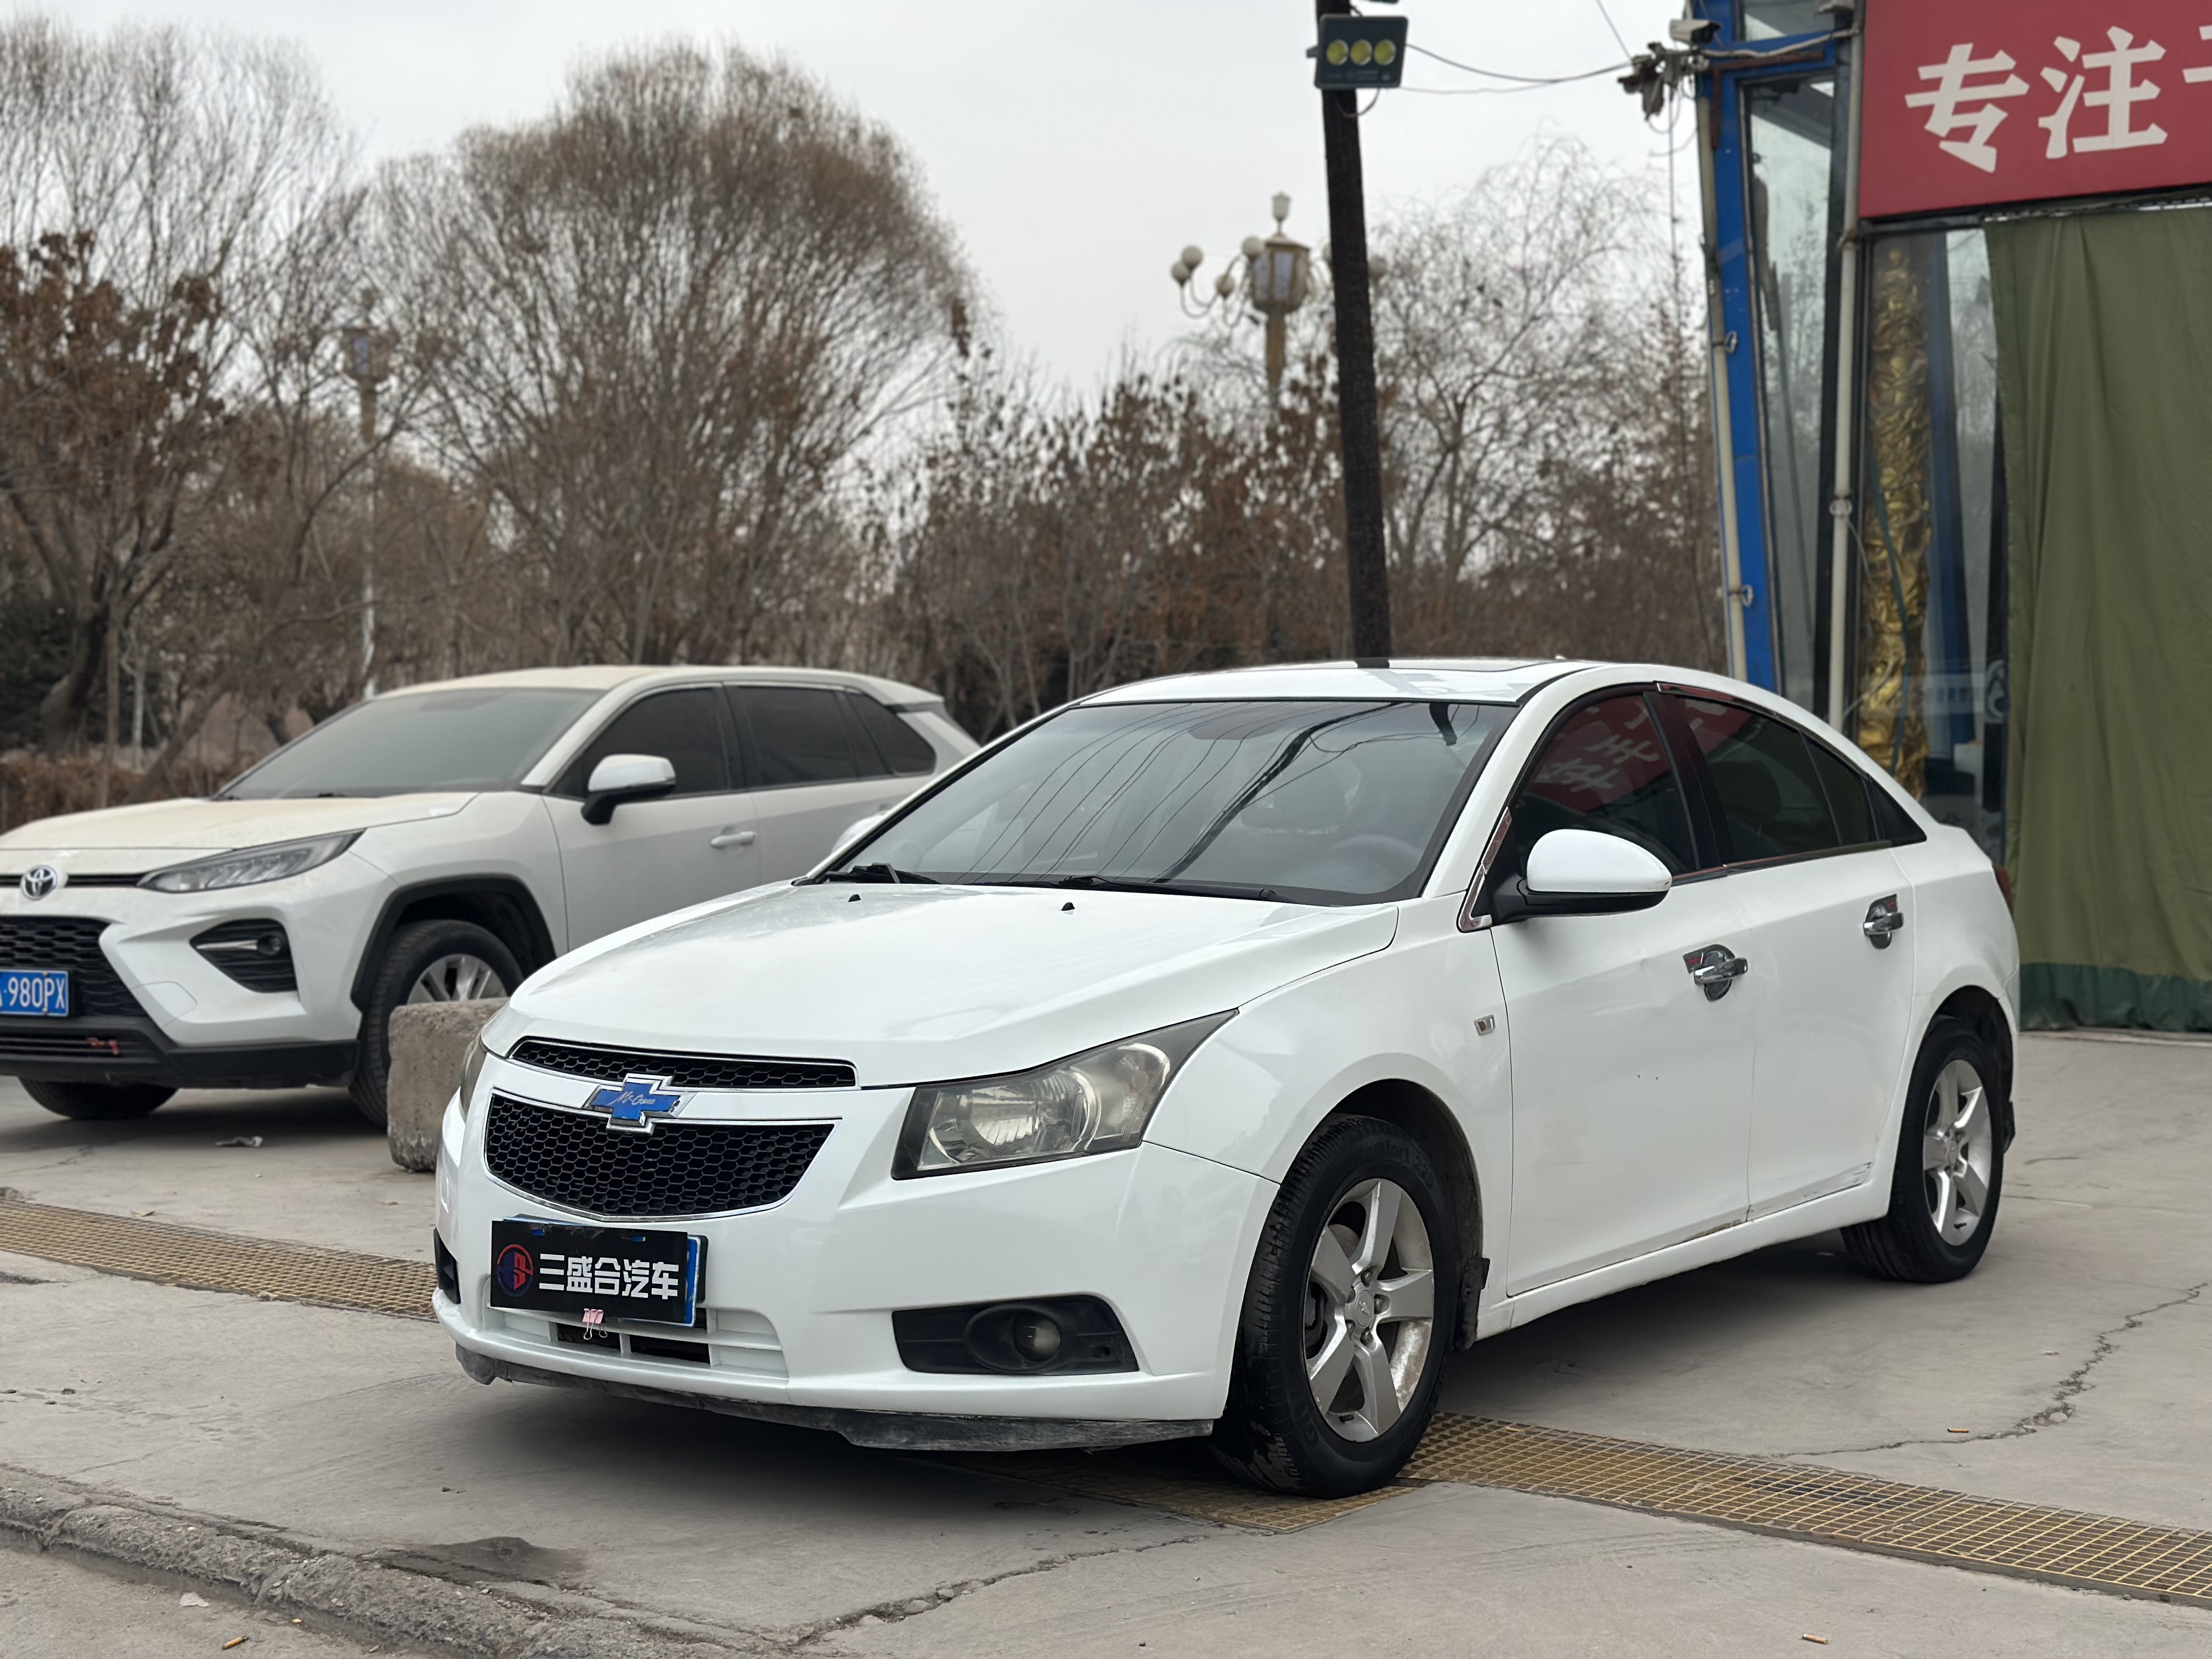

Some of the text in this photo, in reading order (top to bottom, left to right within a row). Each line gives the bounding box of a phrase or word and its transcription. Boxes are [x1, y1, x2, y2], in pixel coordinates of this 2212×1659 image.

[539, 1253, 680, 1300] 三盛合汽车
